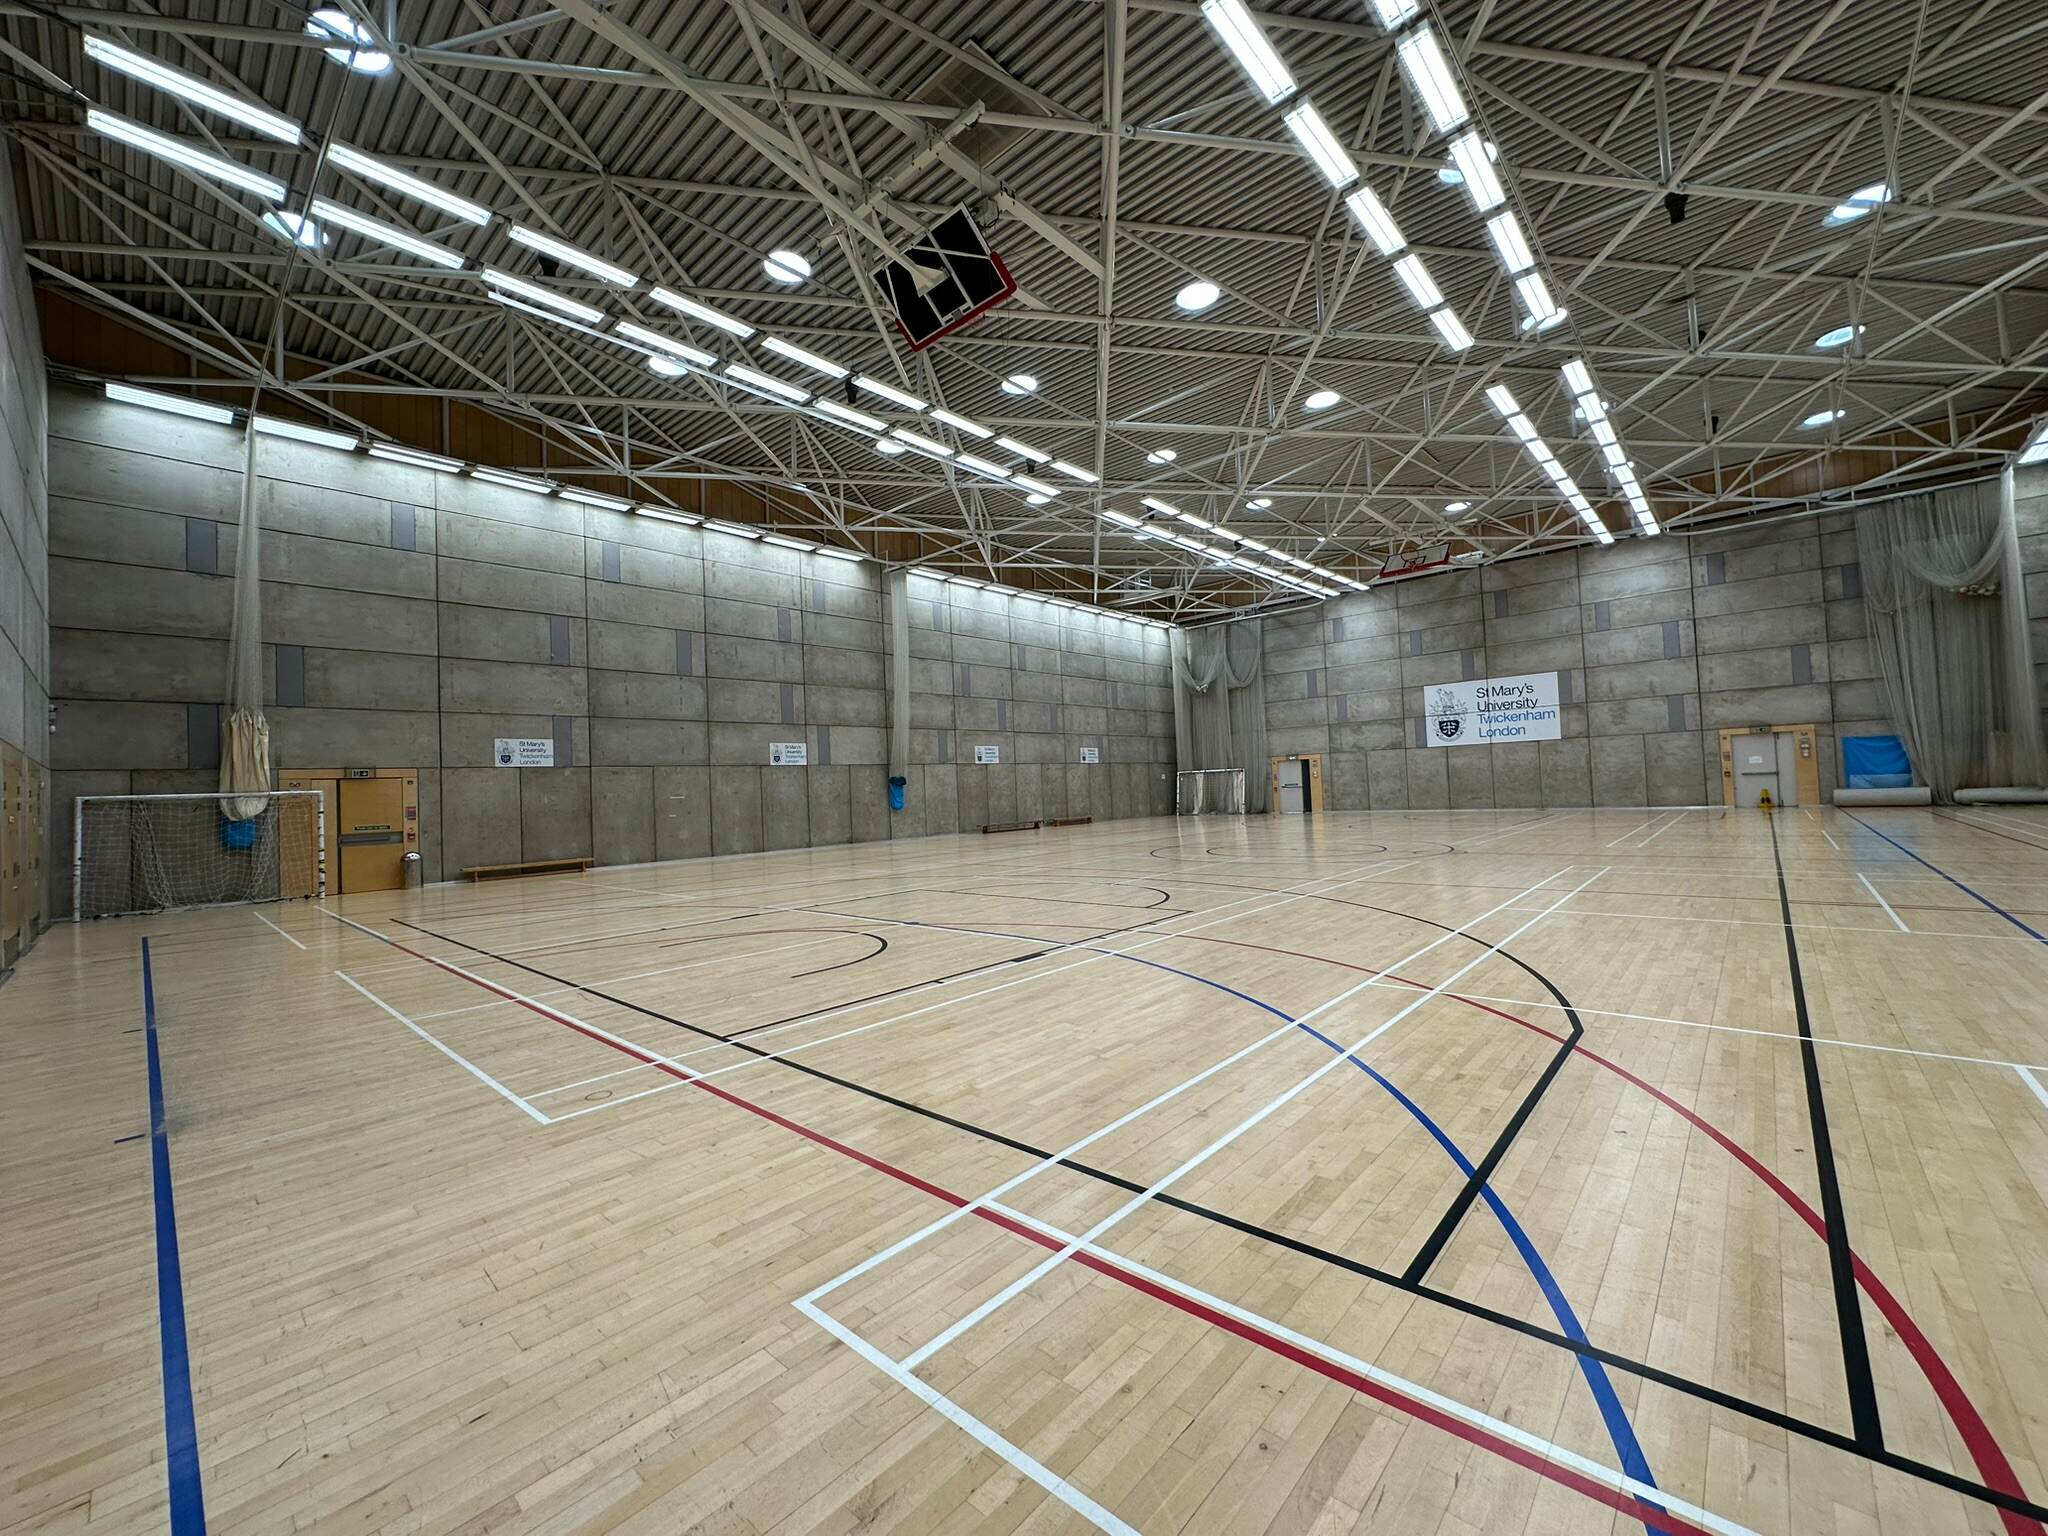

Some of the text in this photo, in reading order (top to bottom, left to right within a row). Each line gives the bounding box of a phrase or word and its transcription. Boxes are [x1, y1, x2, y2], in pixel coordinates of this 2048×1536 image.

[1476, 683, 1534, 699] St Mary's
[1477, 697, 1538, 713] University
[1478, 710, 1556, 724] Twickenham
[1479, 726, 1526, 738] London
